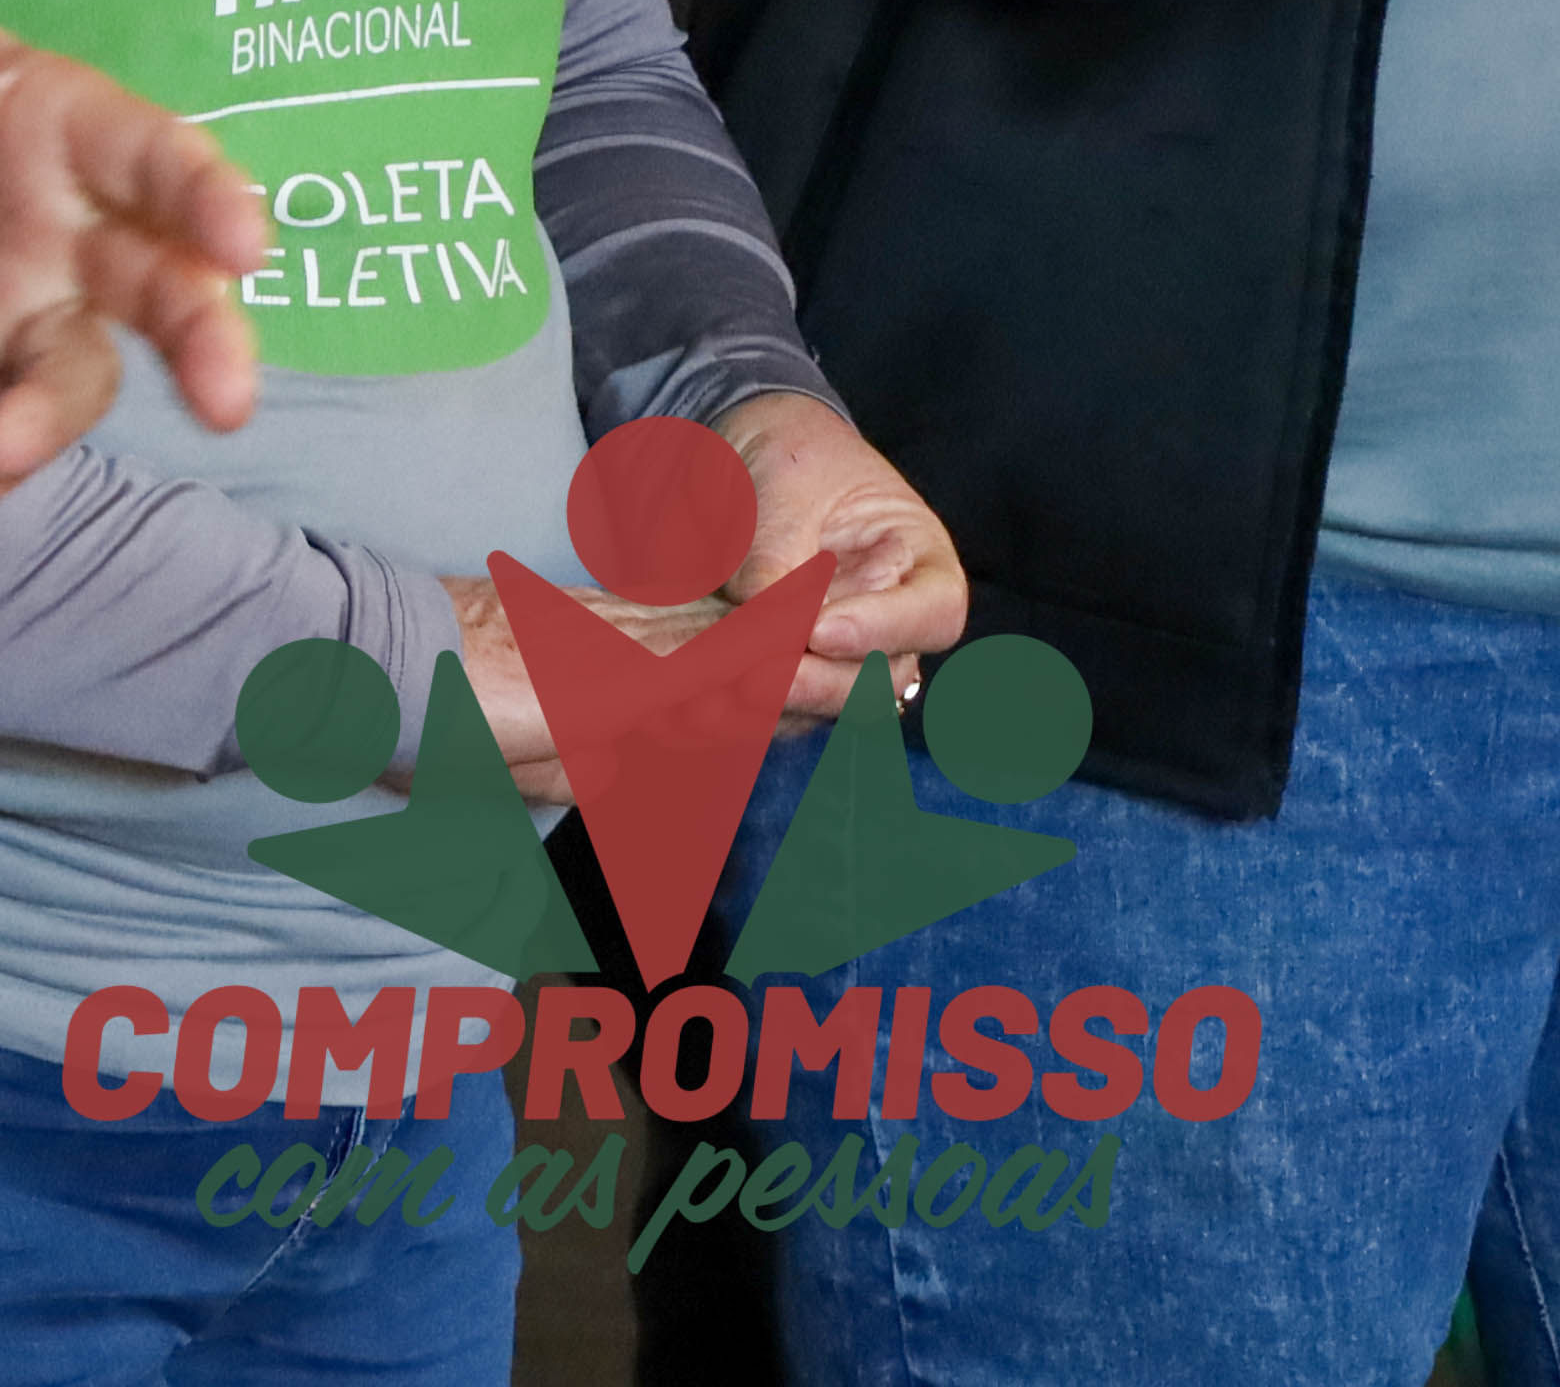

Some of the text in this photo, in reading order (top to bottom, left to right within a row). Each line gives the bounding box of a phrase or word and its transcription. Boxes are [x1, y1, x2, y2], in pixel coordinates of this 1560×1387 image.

[230, 1, 472, 76] BINACIONAL
[246, 157, 516, 228] OLETA
[219, 238, 528, 308] ELETIVA
